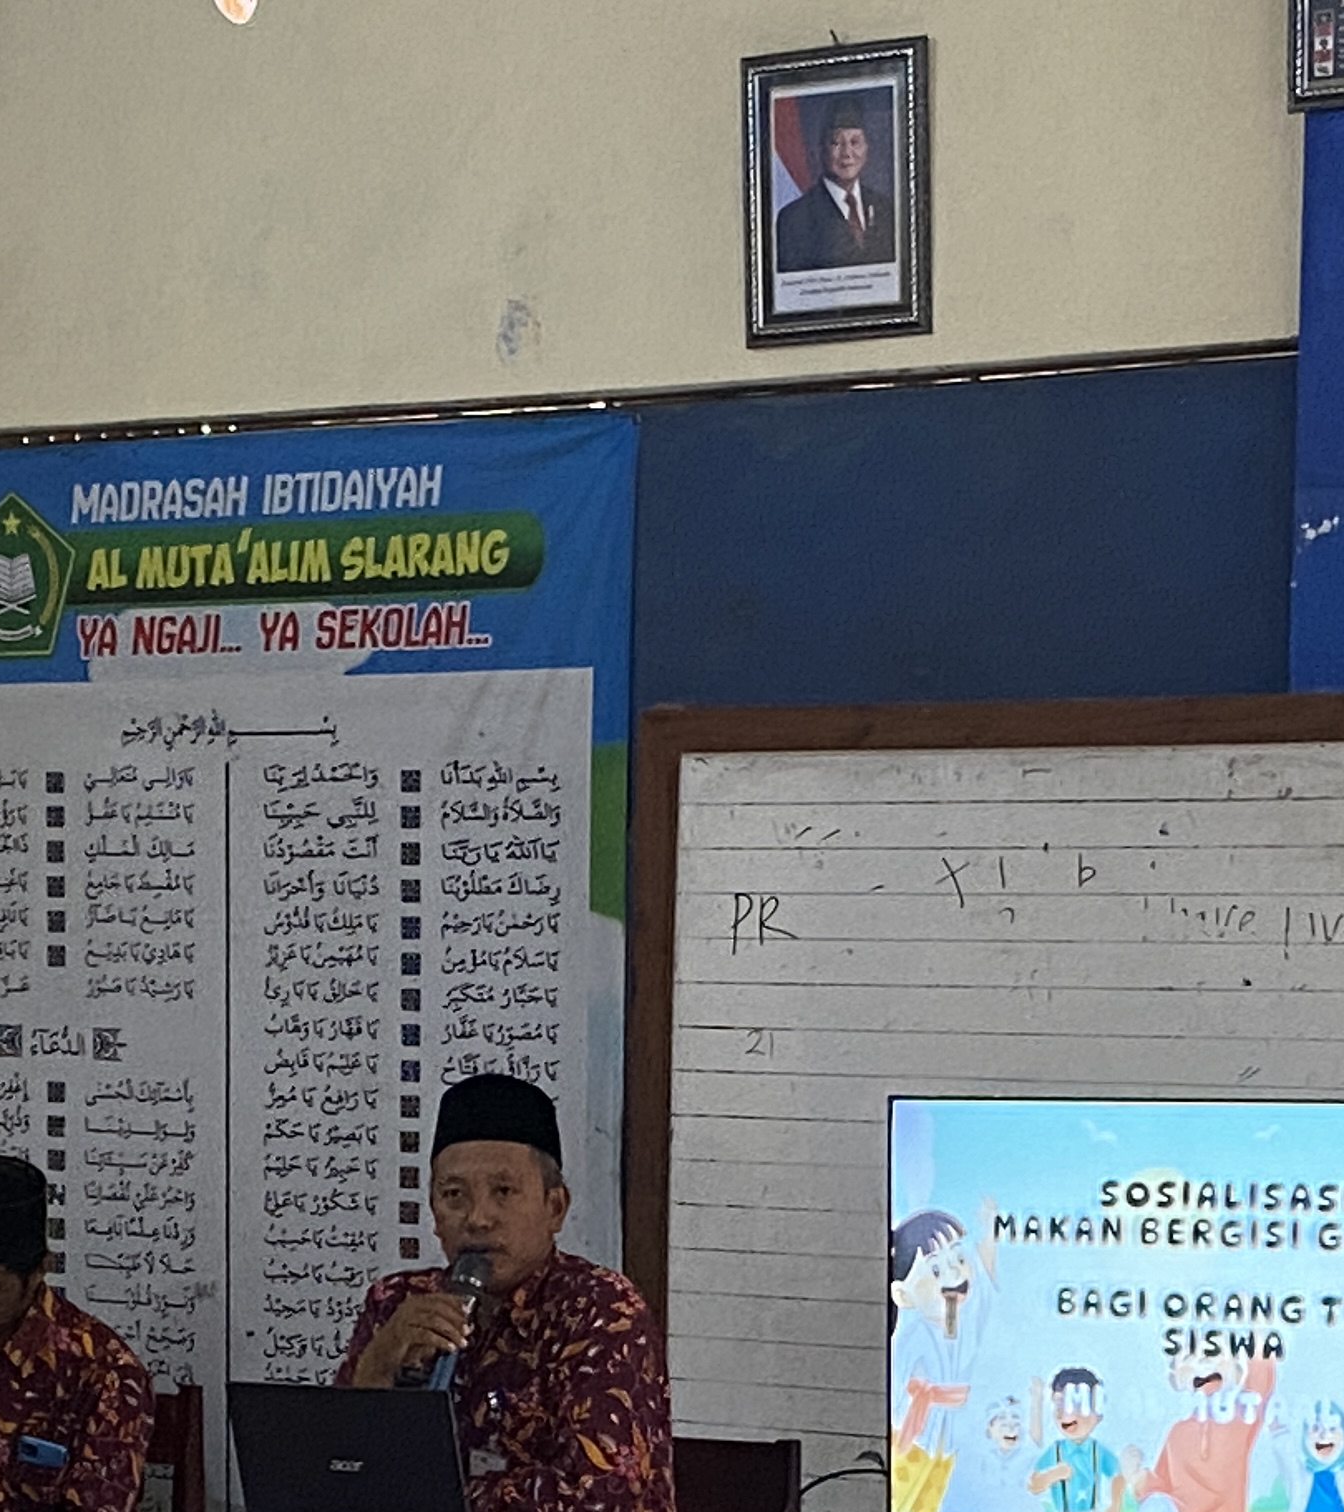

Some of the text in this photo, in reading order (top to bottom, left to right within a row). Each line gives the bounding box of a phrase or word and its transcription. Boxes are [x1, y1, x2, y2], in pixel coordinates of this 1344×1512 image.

[71, 464, 444, 525] MADRASAH IBTIDAIYAH
[86, 548, 129, 591] AL
[340, 529, 511, 582] SLARANG
[78, 614, 118, 659] YA
[259, 610, 300, 652] YA
[731, 892, 800, 956] PR
[993, 1214, 1123, 1245] MAKAN
[1140, 1216, 1301, 1250] BERGISI
[1056, 1286, 1148, 1319] BAGI
[1163, 1290, 1306, 1326] ORANG
[1163, 1327, 1286, 1360] SISWA
[329, 1459, 364, 1472] acer
